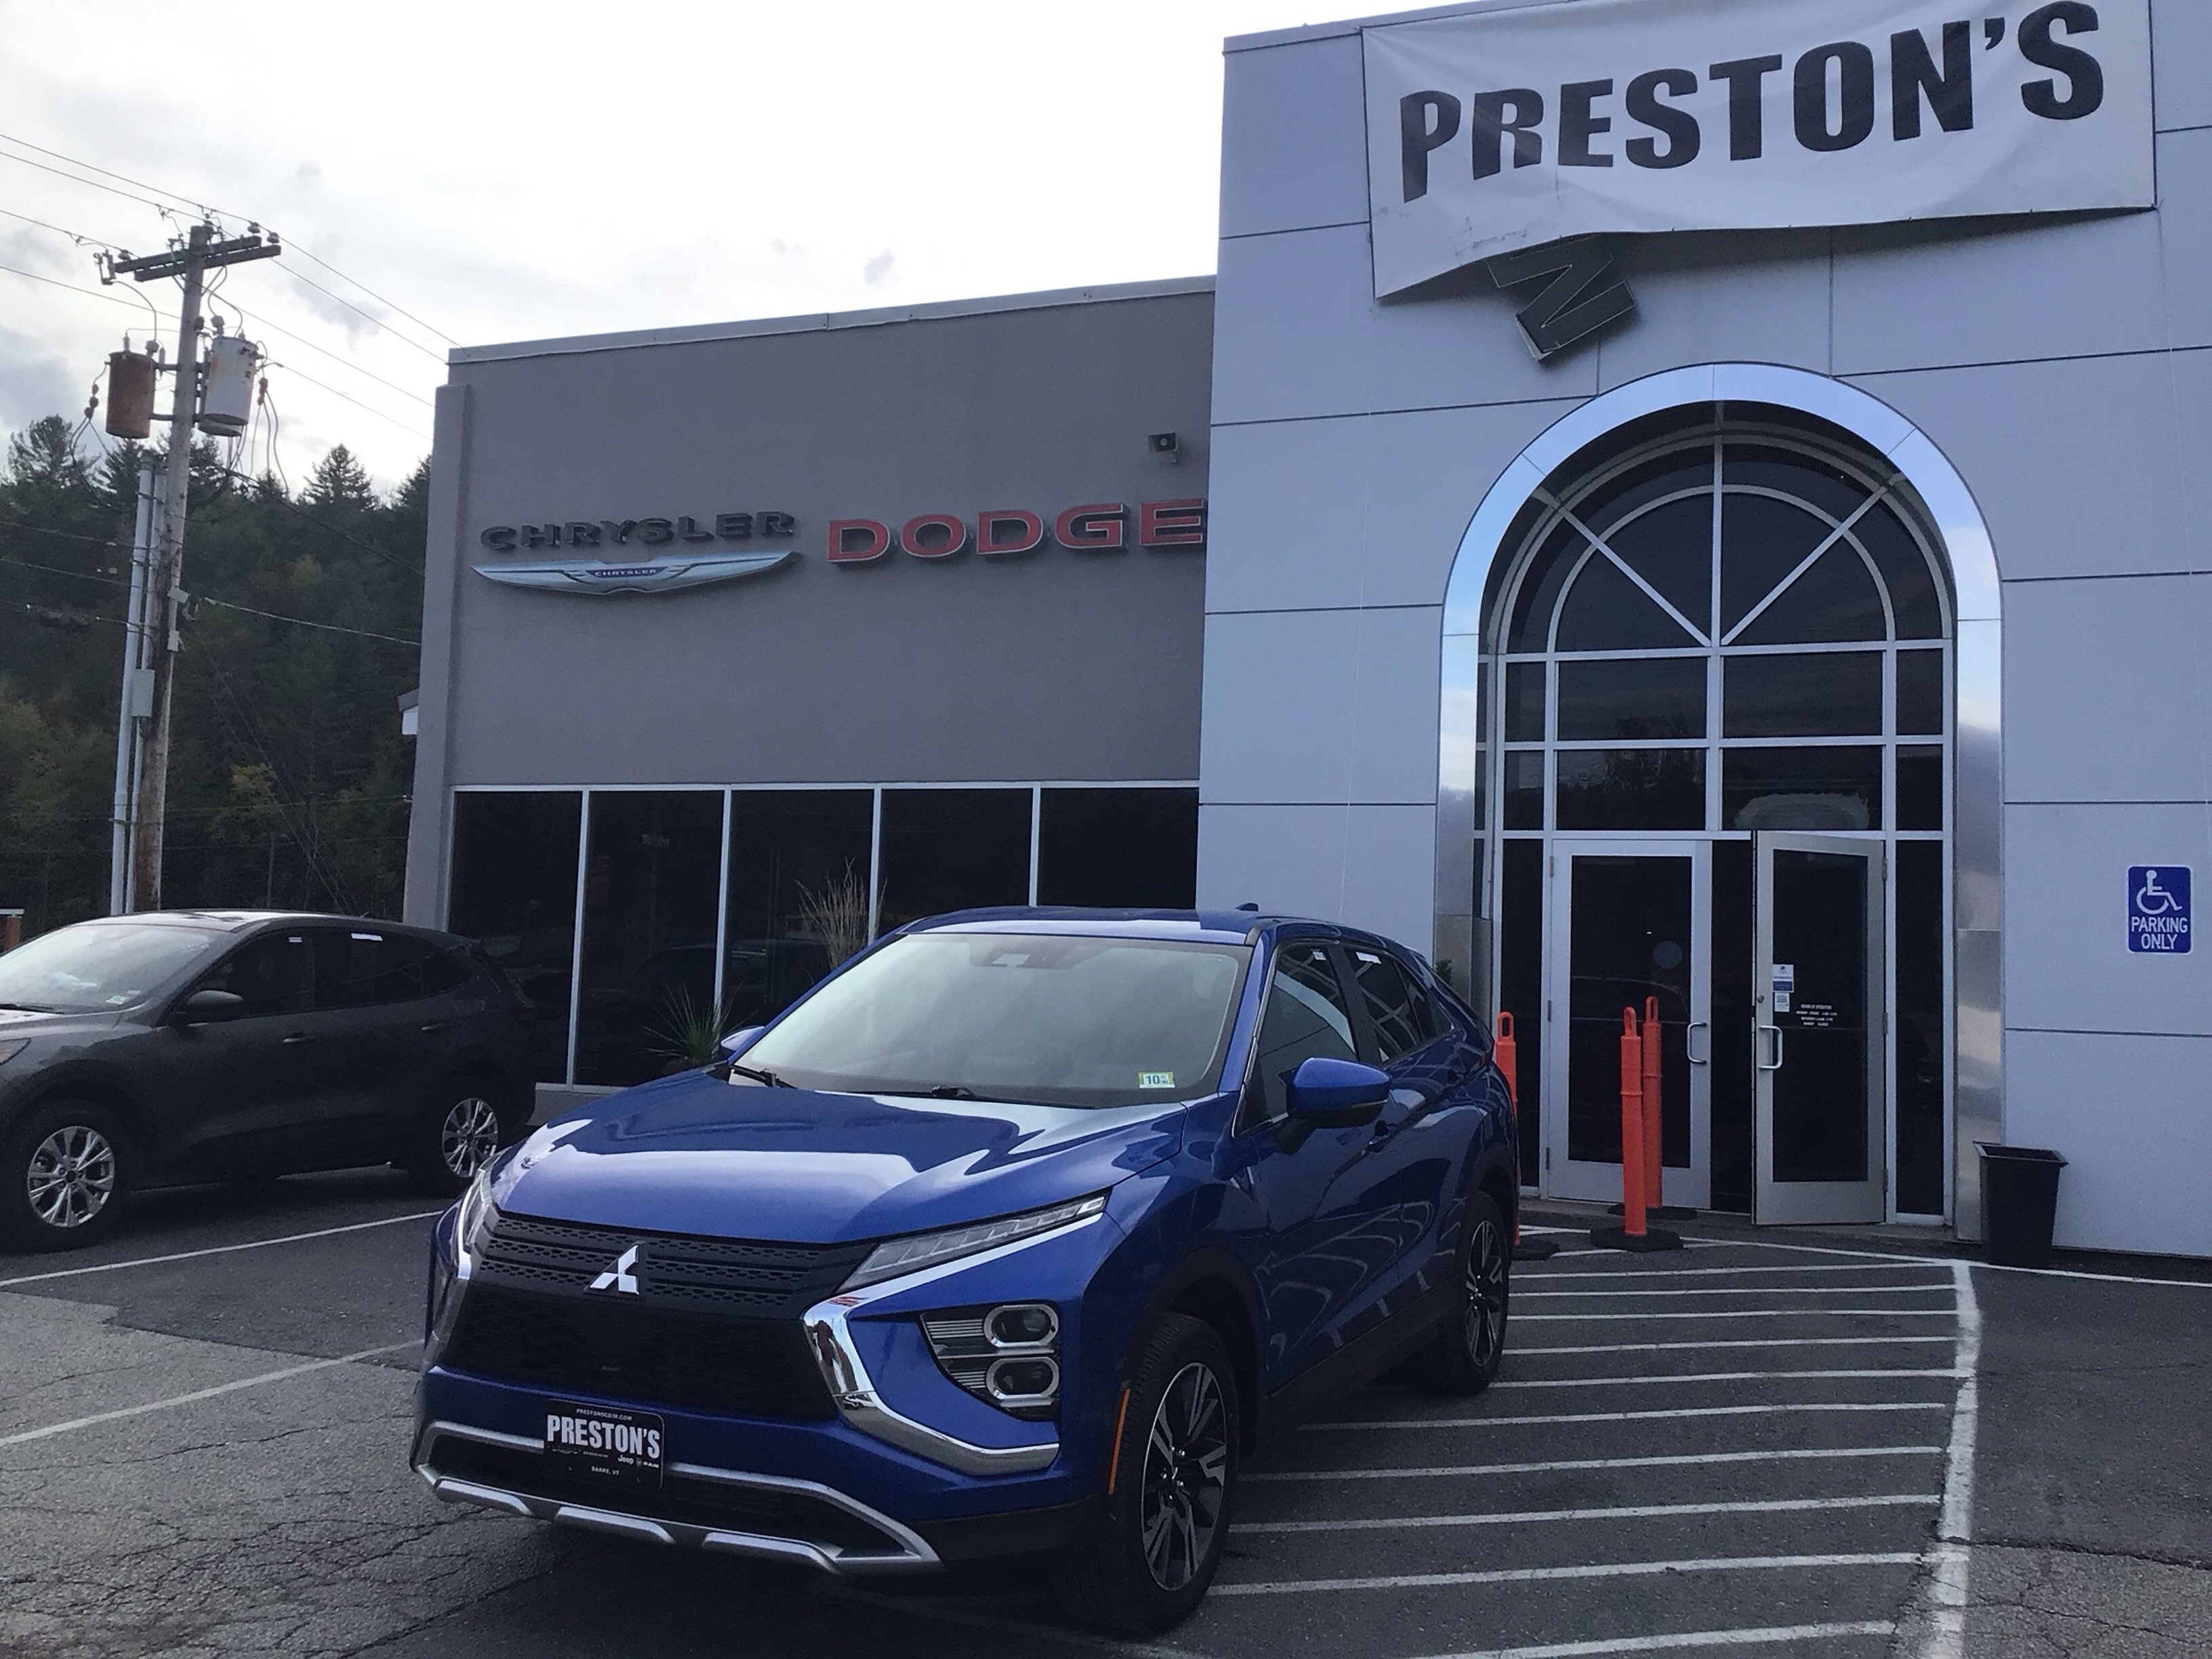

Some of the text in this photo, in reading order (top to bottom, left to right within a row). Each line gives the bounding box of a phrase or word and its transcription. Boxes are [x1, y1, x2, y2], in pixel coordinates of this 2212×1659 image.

[1400, 0, 2104, 203] PRESTON'S
[480, 510, 796, 551] CHRYSLER
[827, 498, 1206, 564] DODGE
[594, 569, 656, 577] CHRYSLER
[2131, 916, 2188, 934] PARKING
[2141, 933, 2178, 949] ONLY
[1145, 1075, 1160, 1084] 10
[547, 1414, 660, 1459] PRESTON'S
[618, 1454, 634, 1465] Jeep
